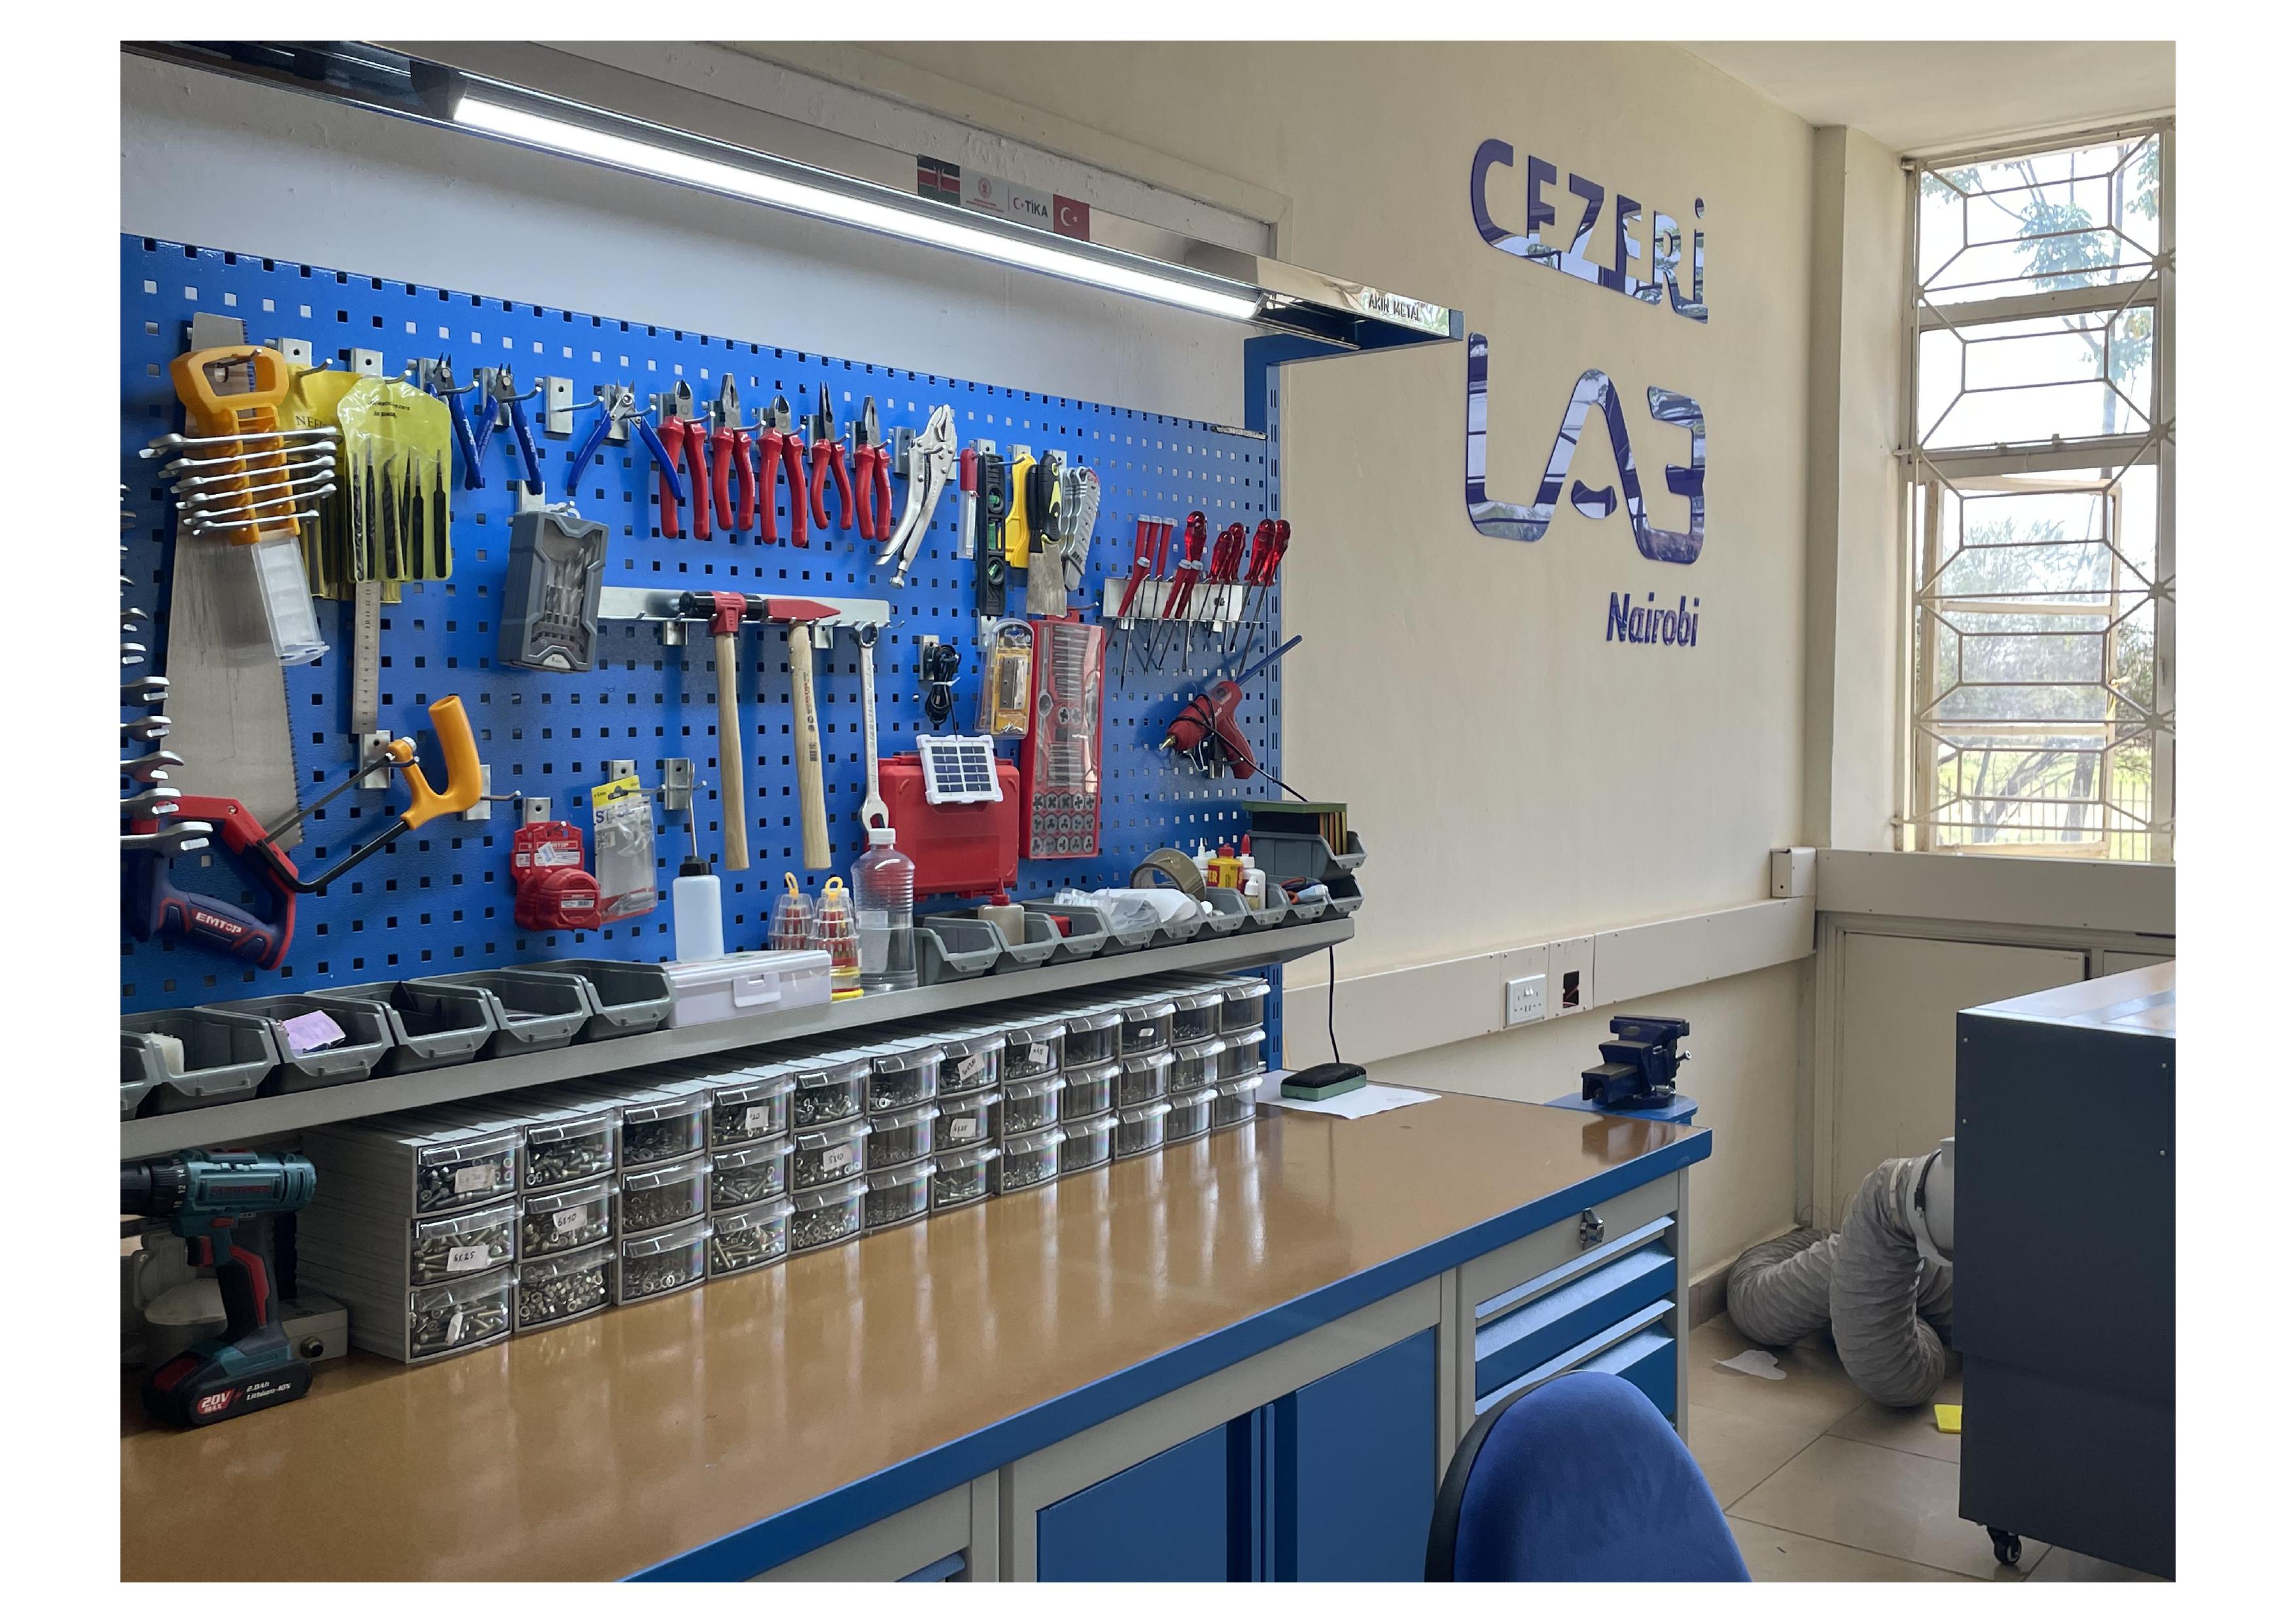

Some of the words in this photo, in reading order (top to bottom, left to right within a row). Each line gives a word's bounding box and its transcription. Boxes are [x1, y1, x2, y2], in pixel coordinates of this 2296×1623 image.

[1025, 199, 1048, 218] TİKA
[1368, 294, 1389, 313] AKIN
[1466, 332, 1706, 564] LAB
[1606, 592, 1699, 647] Nairobi
[196, 912, 242, 933] EMTOP
[177, 1185, 186, 1194] 12
[202, 1391, 232, 1408] 20V
[203, 1404, 222, 1414] MAX
